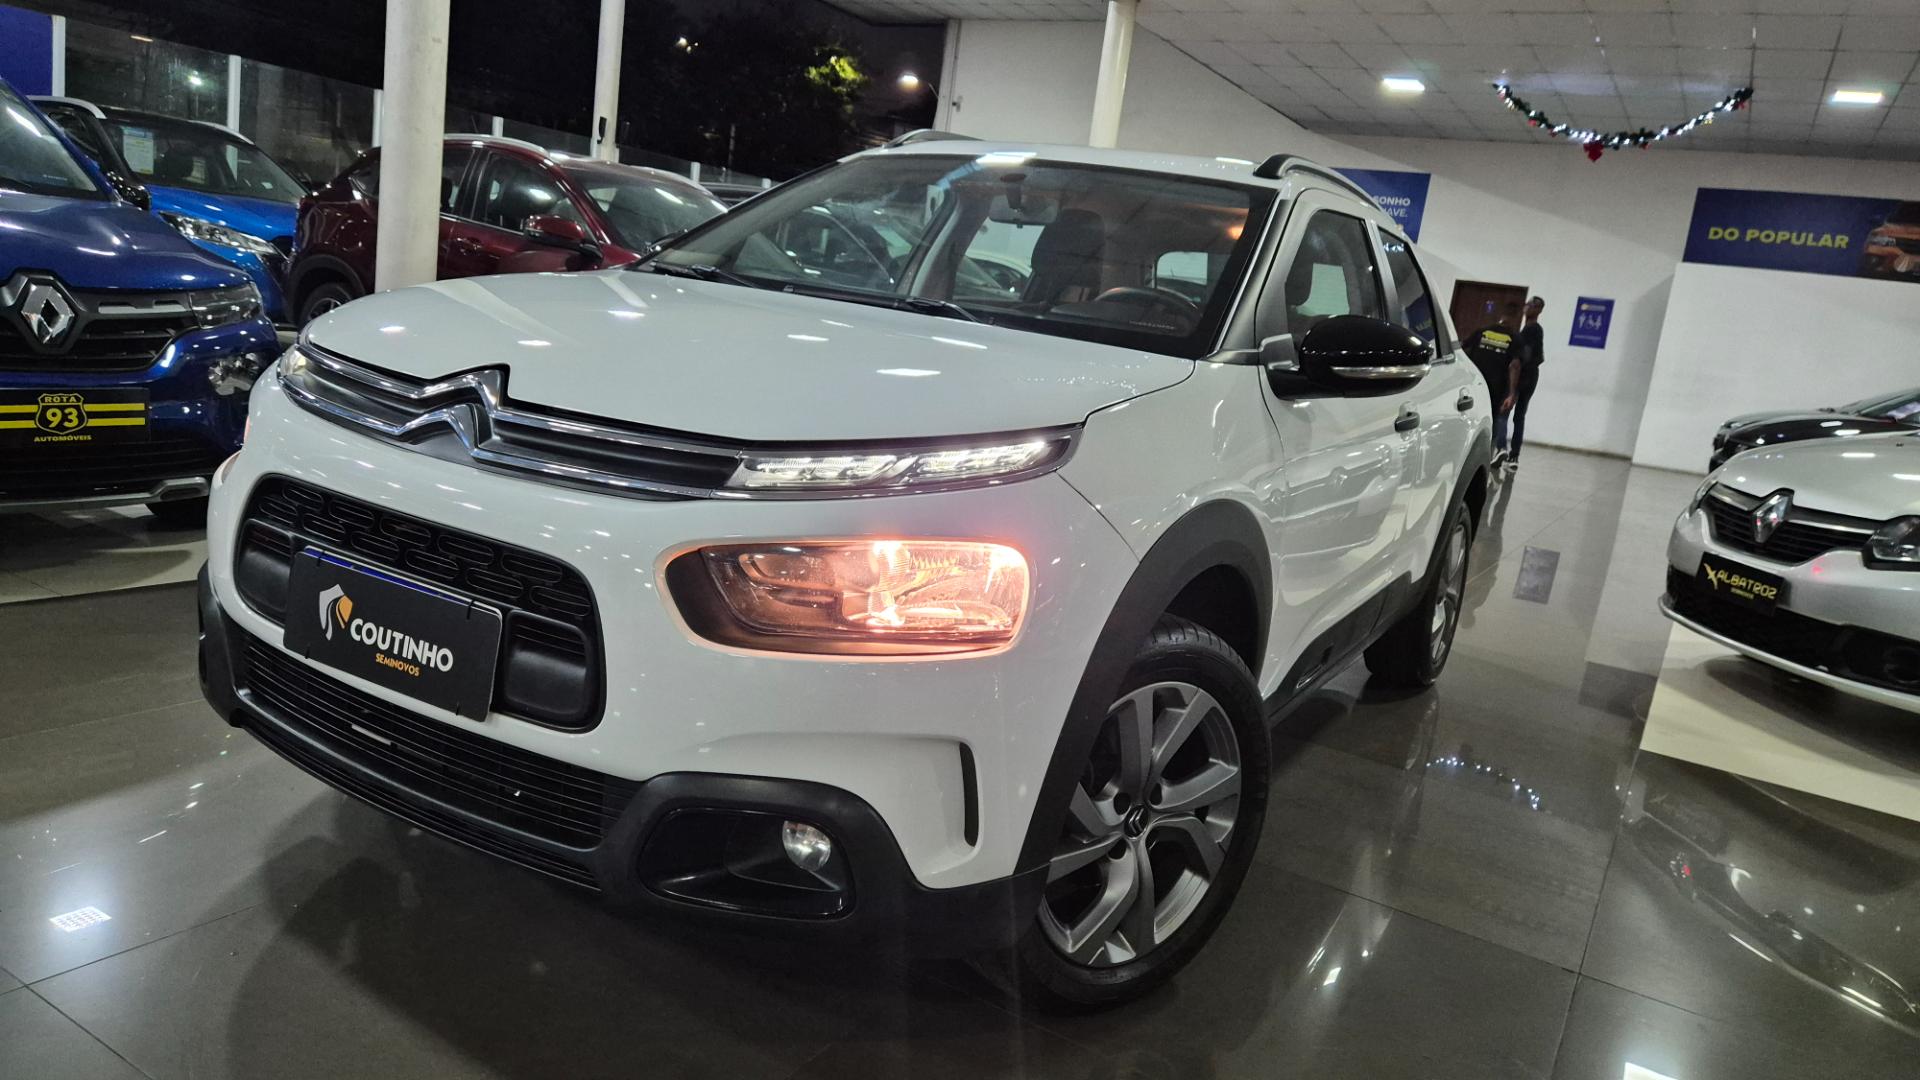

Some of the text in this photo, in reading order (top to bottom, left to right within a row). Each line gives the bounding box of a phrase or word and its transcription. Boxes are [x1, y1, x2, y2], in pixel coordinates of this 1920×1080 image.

[1707, 226, 1850, 249] DO POPULAR
[45, 407, 80, 428] 93
[350, 618, 454, 673] COUTINHO
[375, 652, 420, 677] SEMINOVOS
